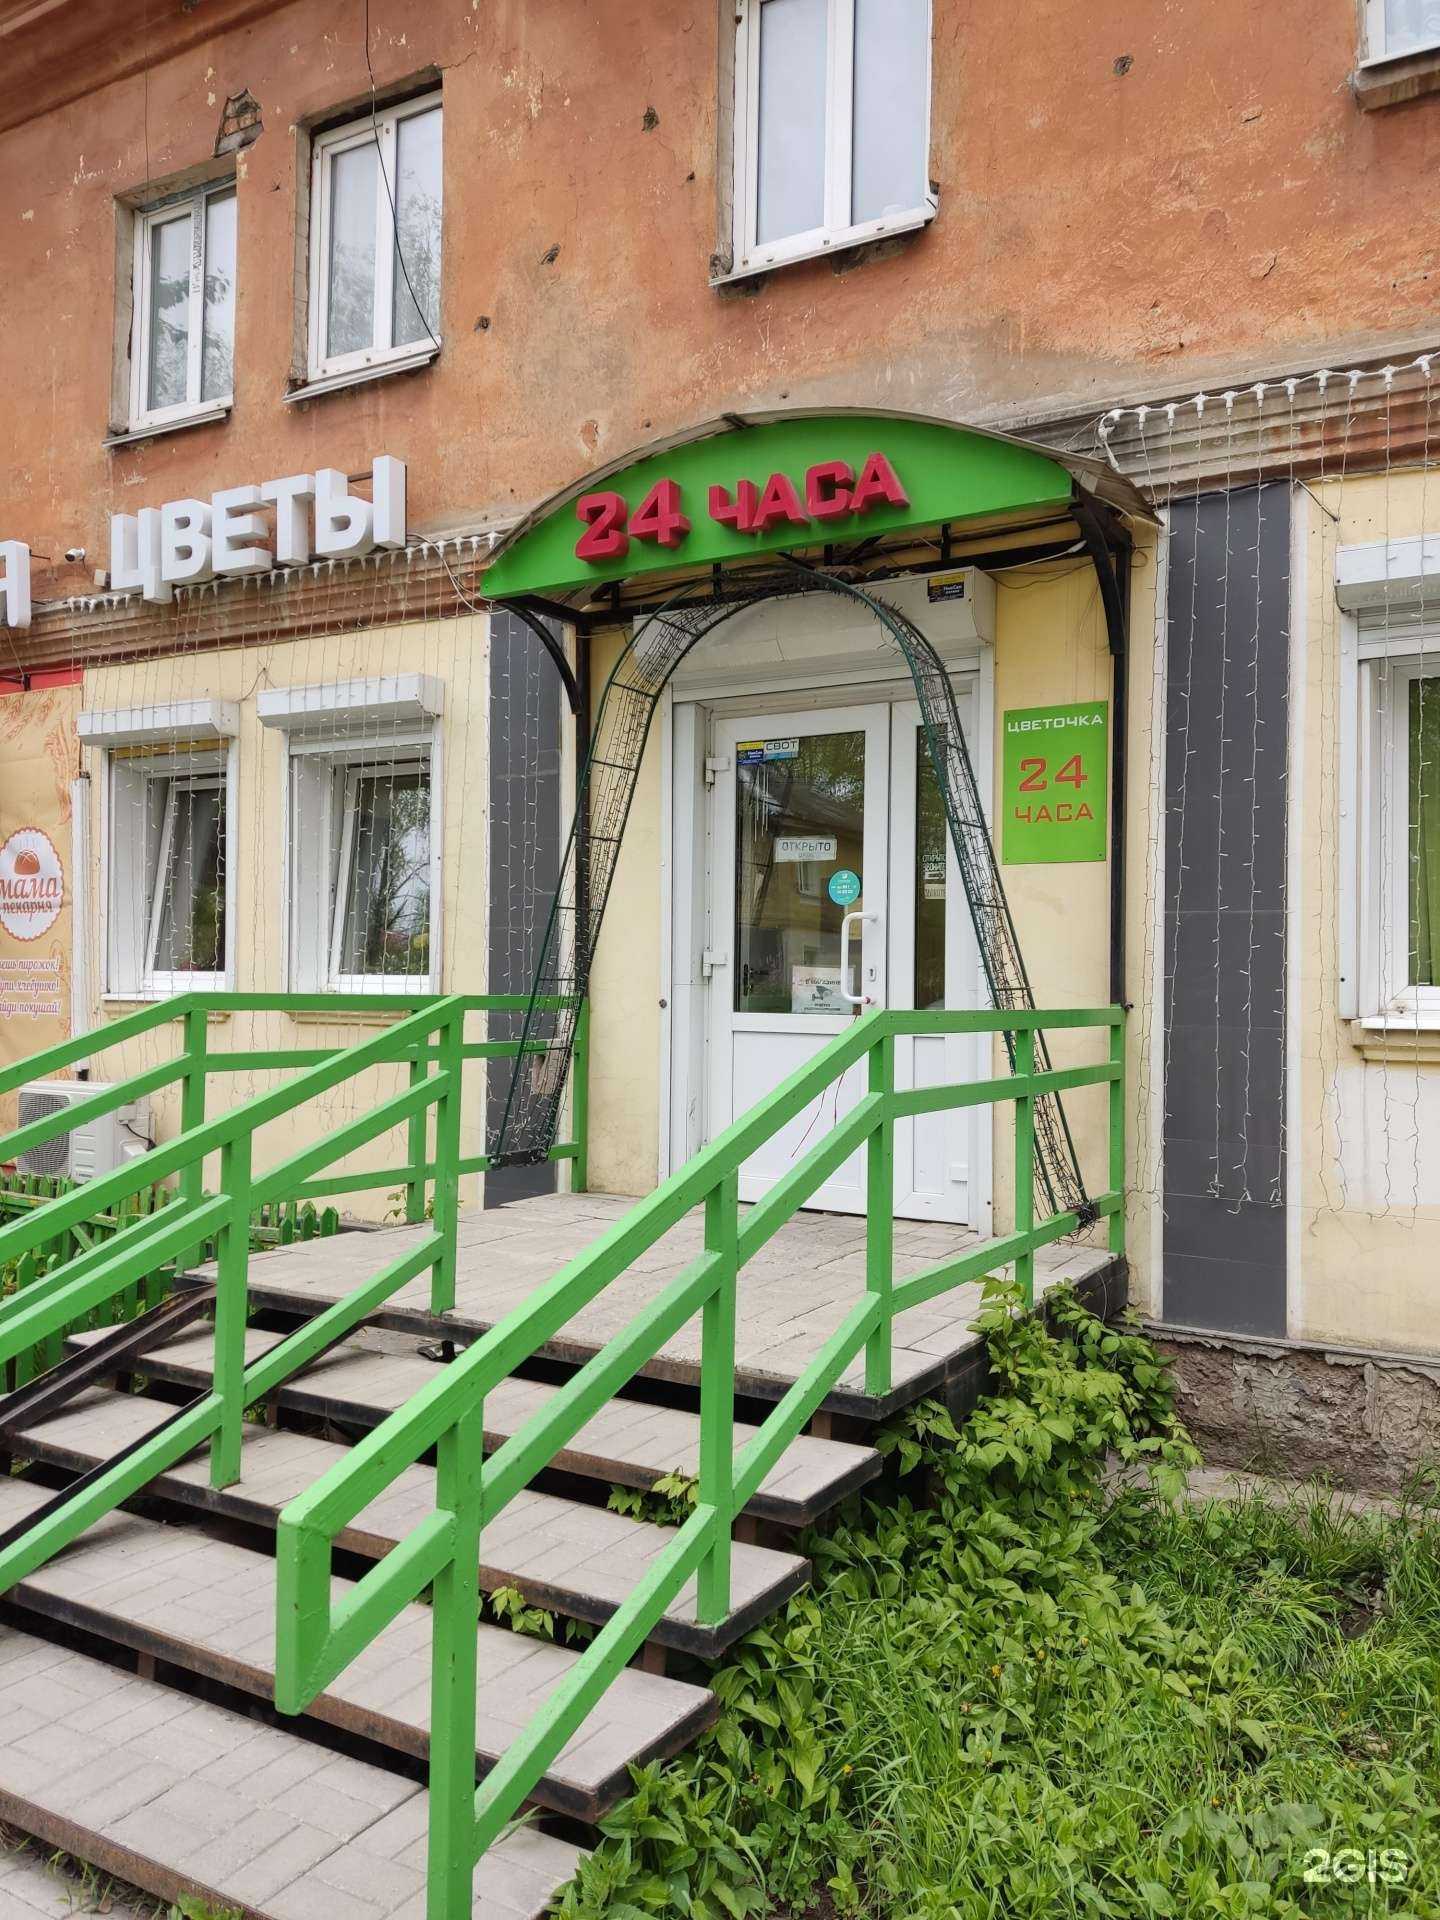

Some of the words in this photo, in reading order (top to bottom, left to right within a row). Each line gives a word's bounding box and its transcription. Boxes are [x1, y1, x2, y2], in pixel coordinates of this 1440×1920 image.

[575, 477, 691, 562] 24
[708, 452, 911, 535] ЧАСА
[110, 455, 407, 605] ЦВЕТЫ
[1007, 714, 1103, 733] ЦВЕТОЧКА
[1019, 754, 1088, 792] 24
[1014, 802, 1094, 824] ЧАСА
[782, 841, 831, 852] ОТКРЫТО
